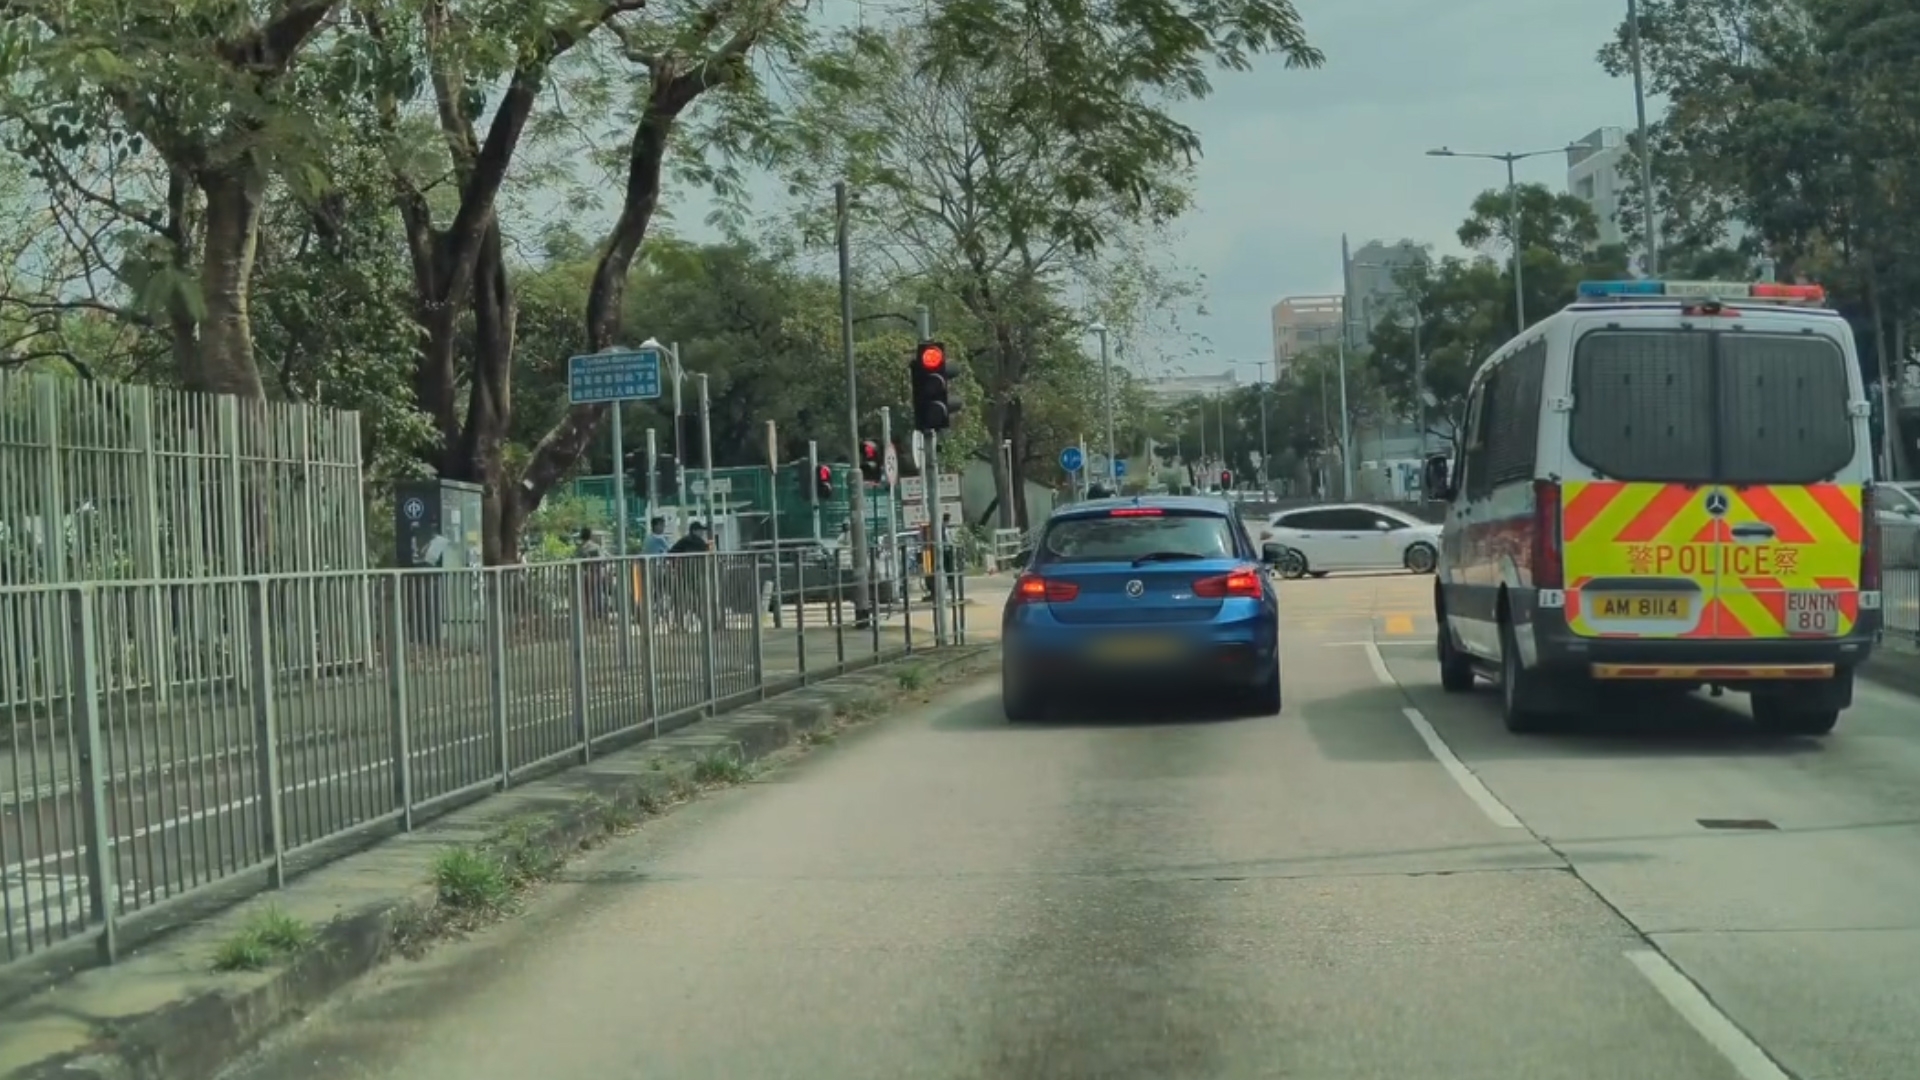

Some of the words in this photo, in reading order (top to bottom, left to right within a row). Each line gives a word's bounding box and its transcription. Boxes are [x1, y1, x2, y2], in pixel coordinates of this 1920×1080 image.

[1604, 598, 1630, 616] AM
[1638, 599, 1678, 616] 8114
[1788, 592, 1836, 611] EUNTN
[1799, 611, 1826, 630] 80
